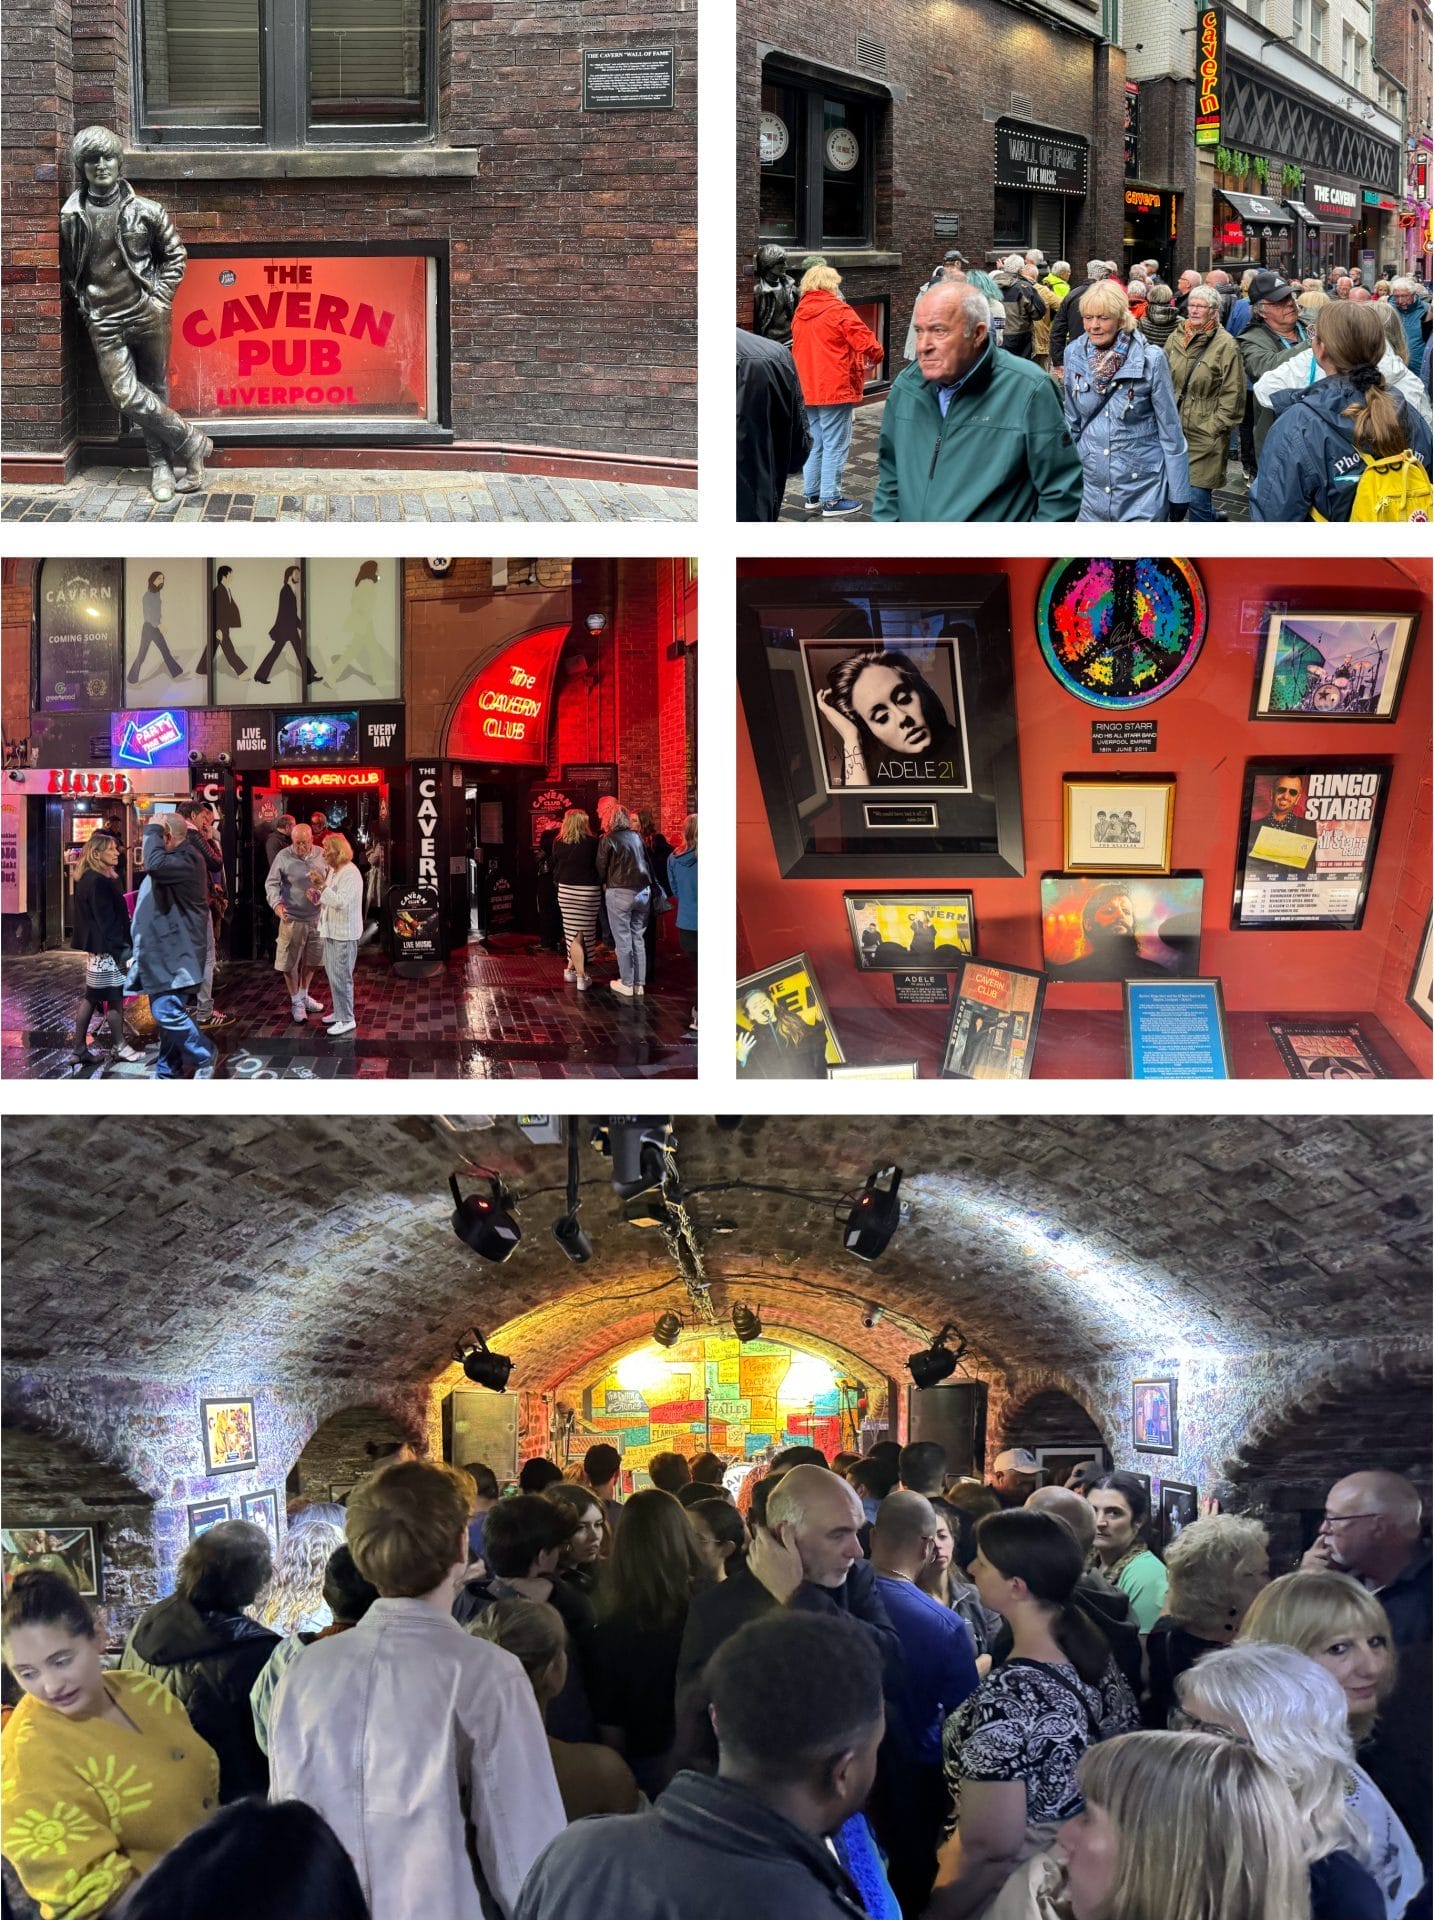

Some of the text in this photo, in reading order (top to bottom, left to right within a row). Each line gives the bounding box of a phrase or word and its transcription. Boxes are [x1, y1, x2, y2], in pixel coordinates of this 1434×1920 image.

[1200, 11, 1220, 115] cavern
[1196, 115, 1220, 124] PUB
[1009, 138, 1077, 171] WALL OF FAME
[1027, 166, 1057, 185] LIVE MUSIC
[1313, 185, 1330, 204] THE
[1330, 188, 1357, 208] CAVERN
[263, 265, 313, 284] THE
[182, 290, 395, 348] CAVERN
[238, 339, 342, 377] PUB
[216, 386, 360, 406] LIVERPOOL
[46, 586, 111, 603] CAVERN
[49, 633, 108, 644] COMING SOON
[478, 690, 542, 718] CAVERN
[136, 717, 173, 743] PARTY
[242, 727, 261, 739] LIVE
[368, 723, 397, 736] EVERY
[483, 717, 526, 740] CLUB
[1096, 722, 1153, 731] RINGO STARR
[236, 738, 267, 751] MUSIC
[373, 735, 392, 748] DAY
[202, 772, 219, 780] THE
[877, 761, 954, 779] ADELE 21
[279, 772, 379, 786] The CAVERN CLUB
[1308, 774, 1378, 797] RINGO
[532, 789, 572, 809] CAVERN
[1305, 797, 1373, 820] STARR
[400, 890, 427, 906] CAVERN
[908, 910, 967, 921] CVERN
[403, 940, 432, 949] LIVE MUSIC
[975, 973, 1005, 989] CAVERN
[977, 985, 997, 999] CLUB
